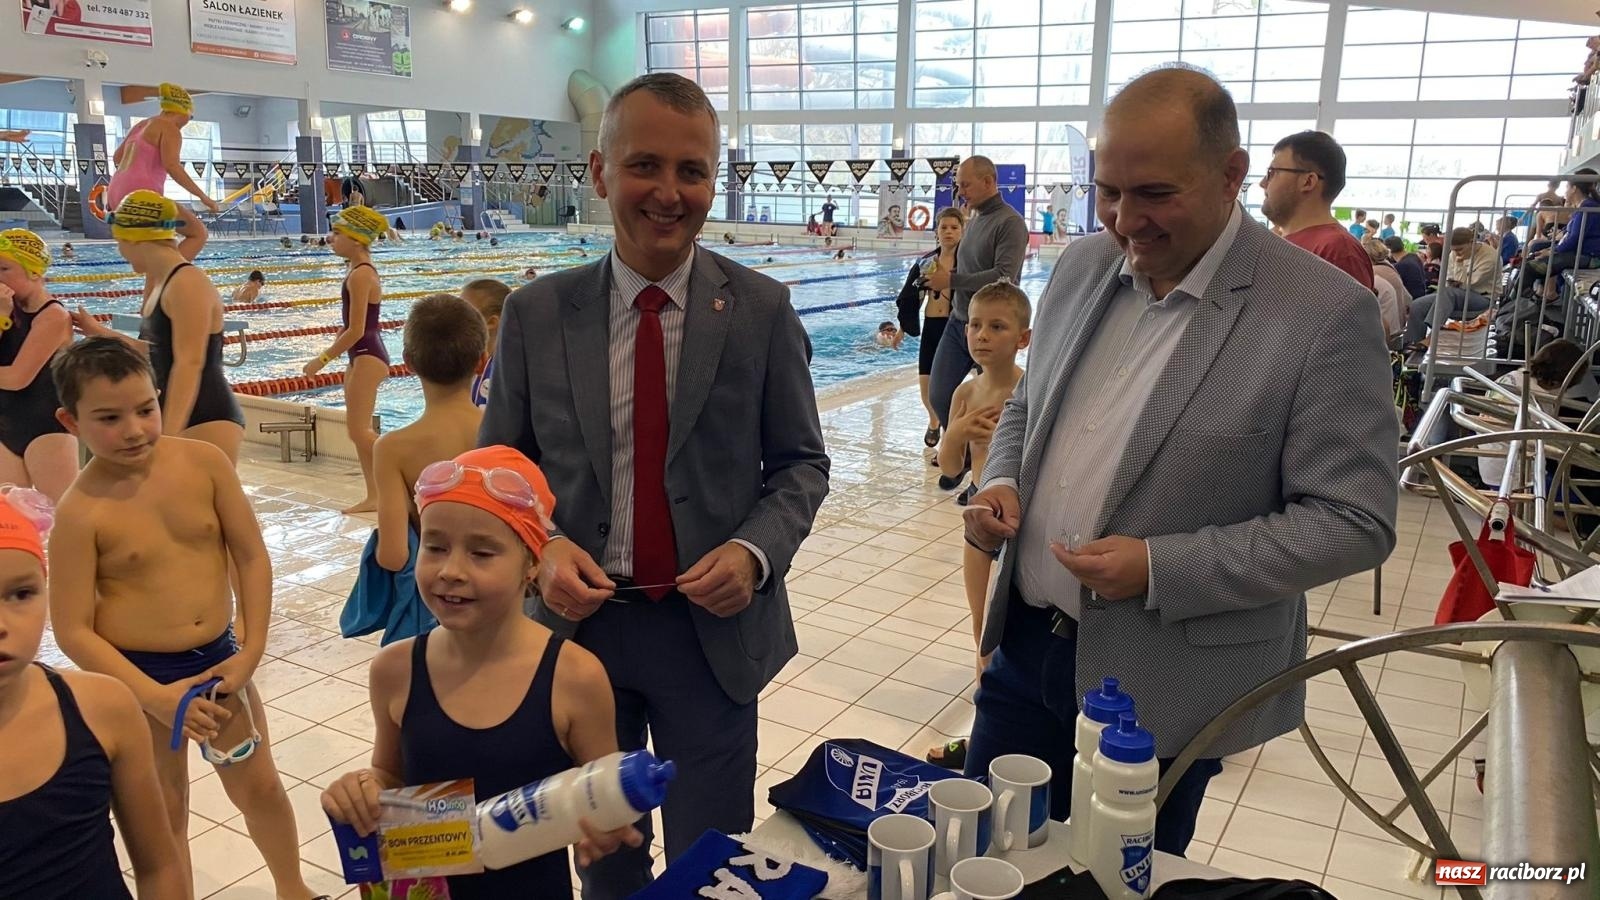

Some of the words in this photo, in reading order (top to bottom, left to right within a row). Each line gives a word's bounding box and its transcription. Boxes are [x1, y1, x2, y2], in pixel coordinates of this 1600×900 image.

[87, 3, 101, 13] tel.
[102, 5, 119, 15] 784
[119, 7, 134, 17] 487
[135, 10, 150, 20] 332
[203, 0, 237, 14] SALON
[239, 6, 284, 21] ŁAZIENEK
[855, 761, 877, 800] UNIA
[408, 831, 467, 846] PREZENTOWY
